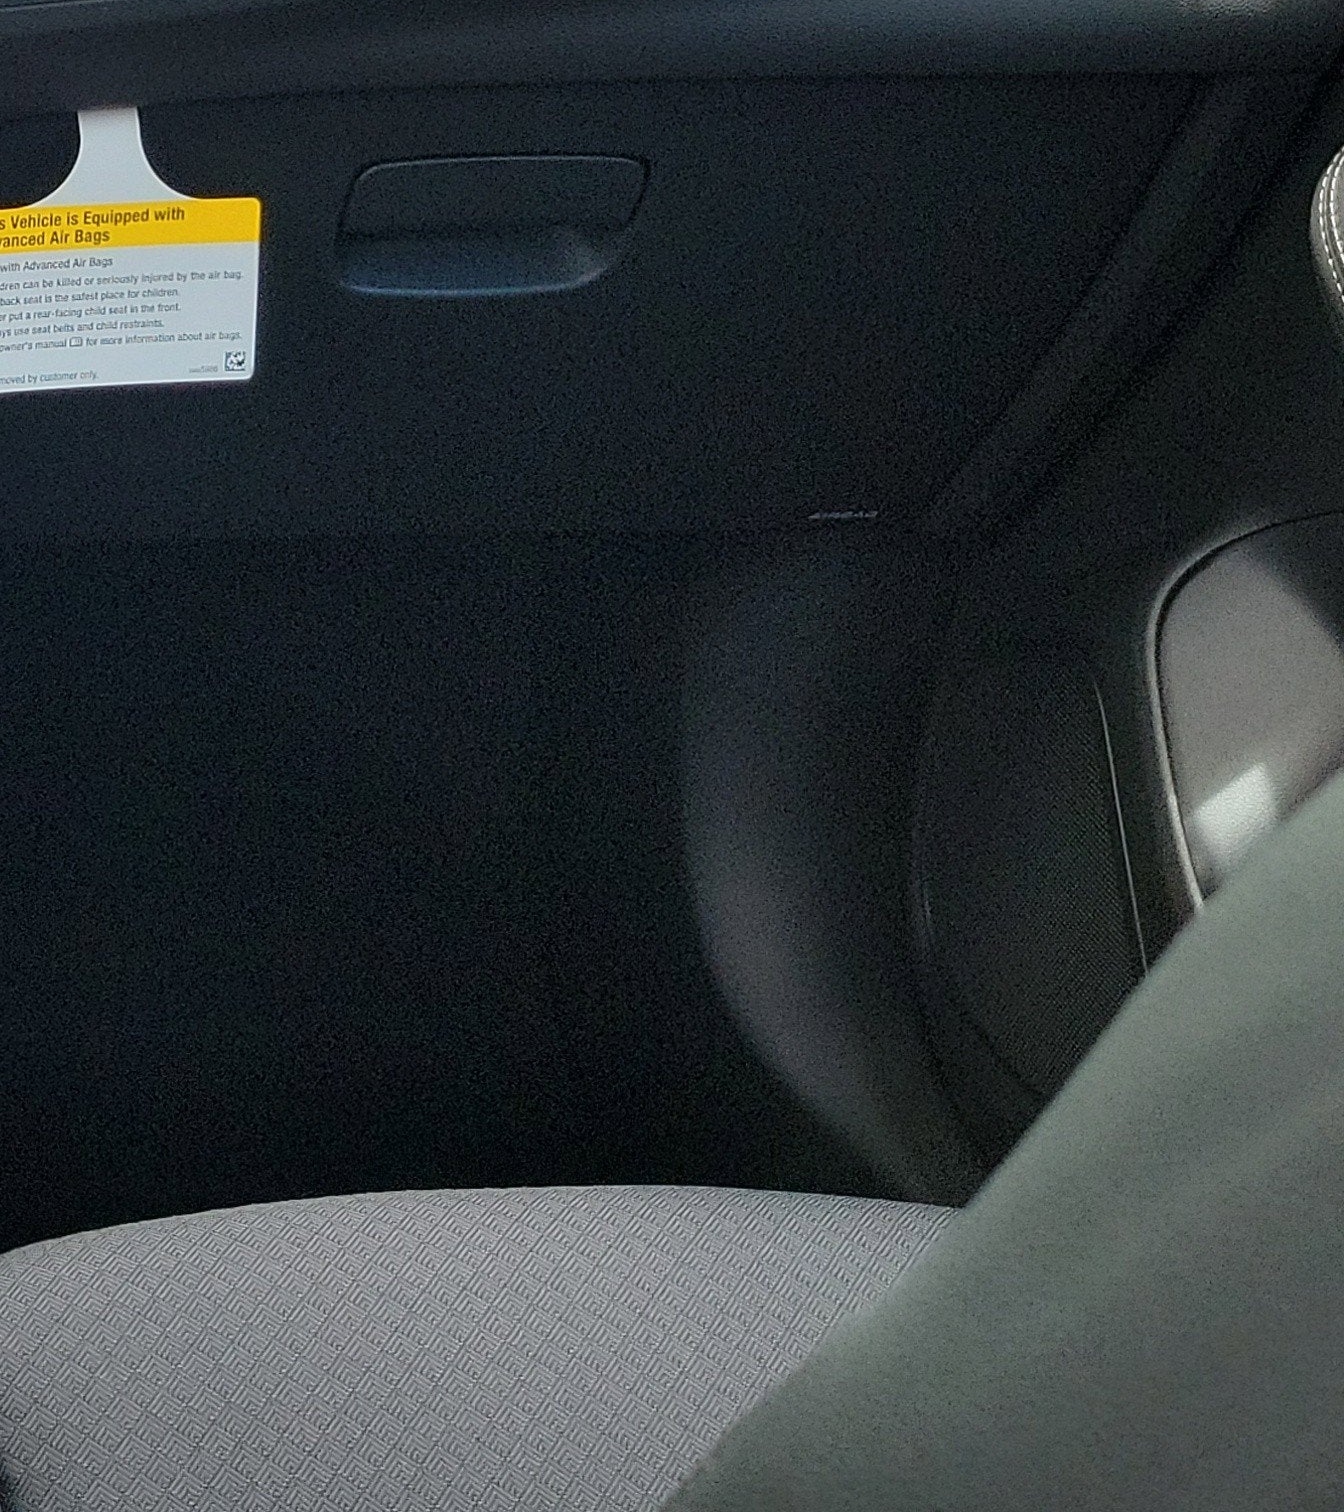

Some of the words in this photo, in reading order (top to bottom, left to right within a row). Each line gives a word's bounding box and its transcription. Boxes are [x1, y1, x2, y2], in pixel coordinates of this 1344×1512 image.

[11, 214, 61, 230] Vehicle
[67, 212, 78, 226] is
[83, 208, 149, 228] Equipped
[155, 207, 185, 221] with
[50, 230, 70, 245] Air
[75, 229, 110, 246] Bags
[0, 262, 21, 272] with
[23, 259, 70, 271] Advanced
[72, 258, 86, 268] Air
[89, 257, 113, 268] Bags
[23, 281, 39, 289] can
[42, 278, 54, 288] be
[56, 276, 82, 287] killed
[84, 277, 95, 286] or
[97, 274, 138, 286] seriously
[141, 272, 174, 284] injured
[177, 271, 187, 282] by
[190, 271, 205, 281] the
[208, 270, 220, 280] air
[0, 296, 20, 307] back
[23, 295, 42, 305] seat
[54, 293, 69, 303] the
[72, 291, 98, 301] safest
[100, 290, 125, 302] place
[127, 289, 140, 298] for
[8, 311, 23, 322] put
[33, 308, 82, 320] rear-facing
[84, 306, 106, 316] child
[109, 305, 127, 315] seat
[140, 303, 155, 313] the
[14, 327, 30, 336] use
[32, 325, 51, 335] seat
[53, 324, 75, 334] belts
[77, 322, 93, 332] and
[95, 320, 118, 331] child
[35, 339, 67, 350] manual
[85, 336, 97, 346] for
[99, 336, 122, 345] more
[125, 333, 175, 344] information
[177, 331, 202, 342] about
[204, 331, 217, 340] air
[28, 374, 38, 384] by
[39, 371, 77, 382] customer
